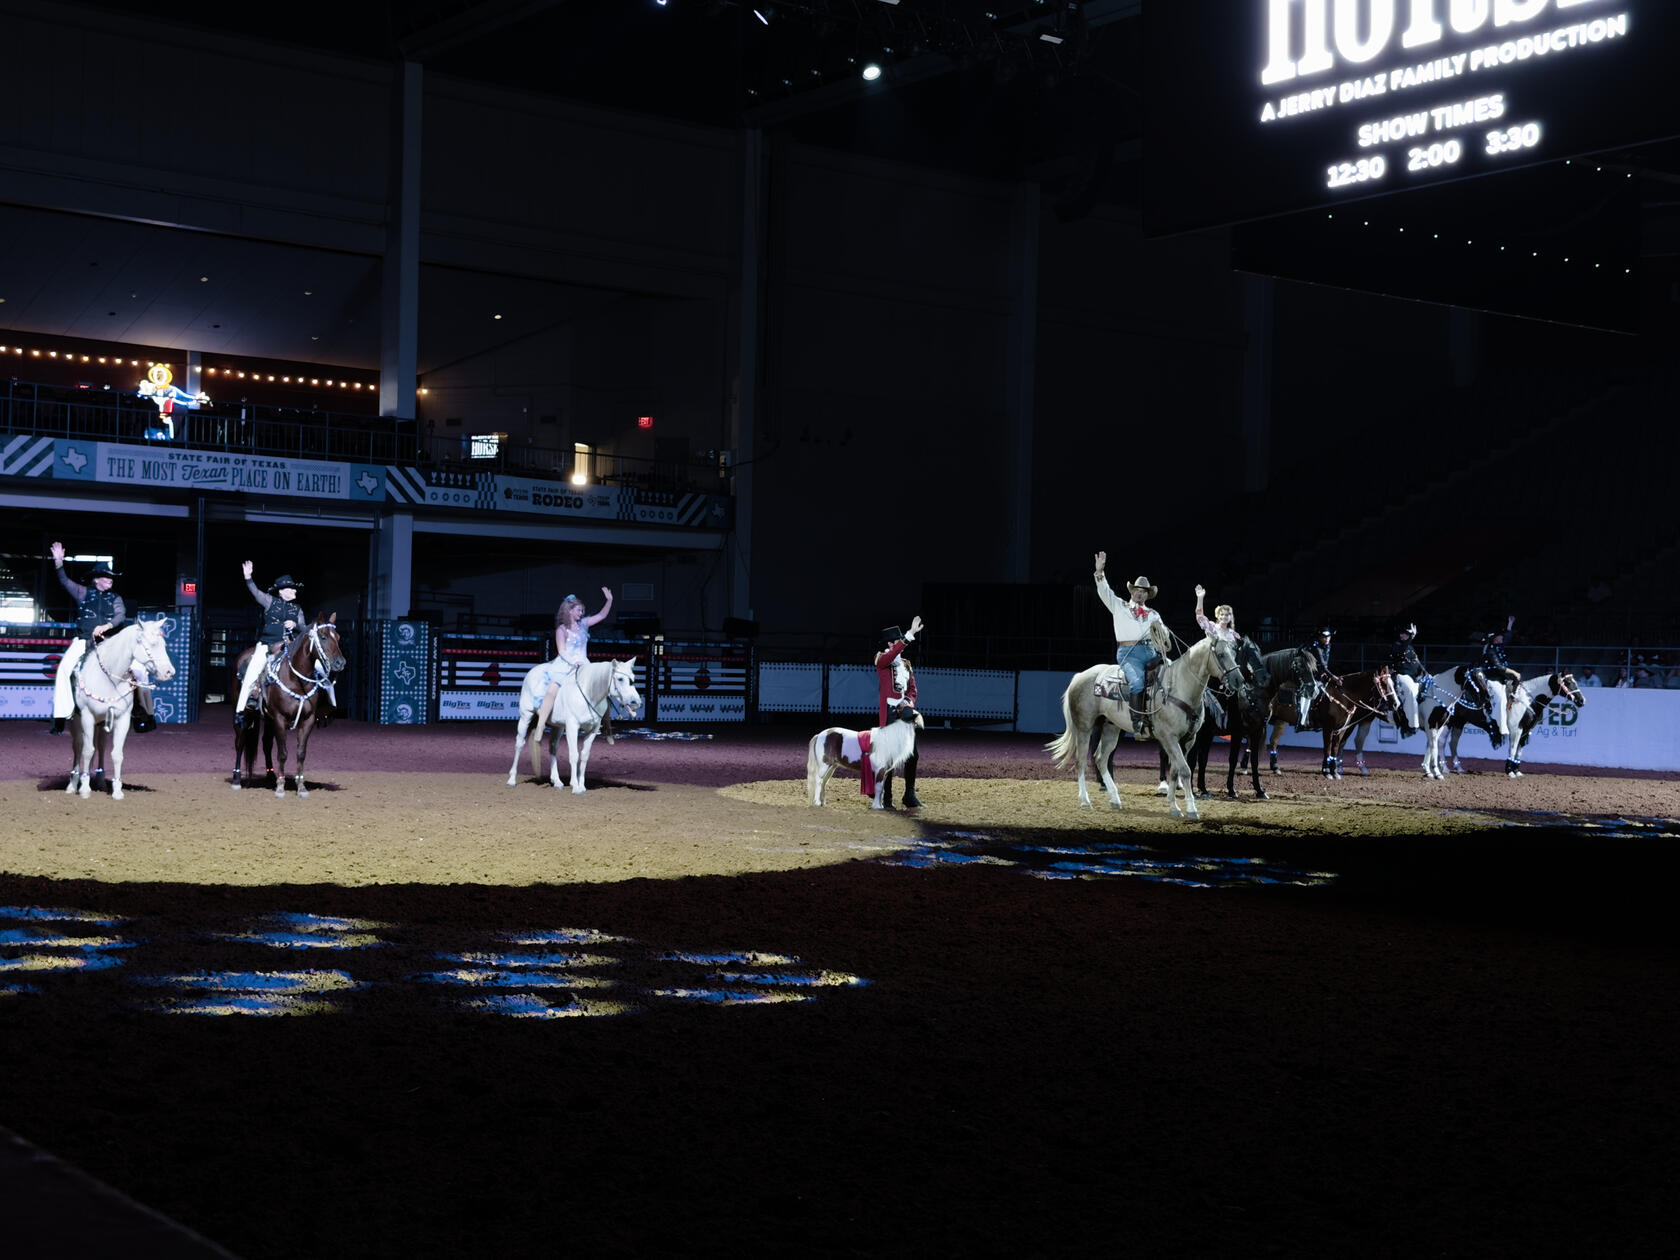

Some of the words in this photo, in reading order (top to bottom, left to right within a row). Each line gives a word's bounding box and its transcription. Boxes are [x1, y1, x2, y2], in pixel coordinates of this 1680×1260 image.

[1261, 102, 1276, 121] A
[1277, 86, 1336, 118] JERRY
[1340, 73, 1387, 103] DIAZ
[1391, 52, 1468, 90] FAMILY
[1470, 14, 1627, 70] PRODUCTION
[1358, 112, 1429, 147] SHOW
[1431, 94, 1505, 131] TIMES
[1327, 156, 1386, 188] 12:30
[1408, 140, 1461, 171] 2:00
[1485, 124, 1540, 155] 3:30
[107, 457, 135, 478] THE
[142, 460, 177, 481] MOST
[182, 464, 228, 481] Texan
[231, 467, 268, 488] PLACE
[274, 471, 291, 490] ON
[297, 472, 341, 493] EARTH!
[168, 453, 203, 462] STATE
[206, 456, 230, 465] FAIR
[234, 457, 246, 465] OF
[252, 459, 285, 469] TEXAS
[532, 493, 583, 509] RODEO
[1536, 726, 1549, 738] Ag
[1552, 727, 1558, 736] &
